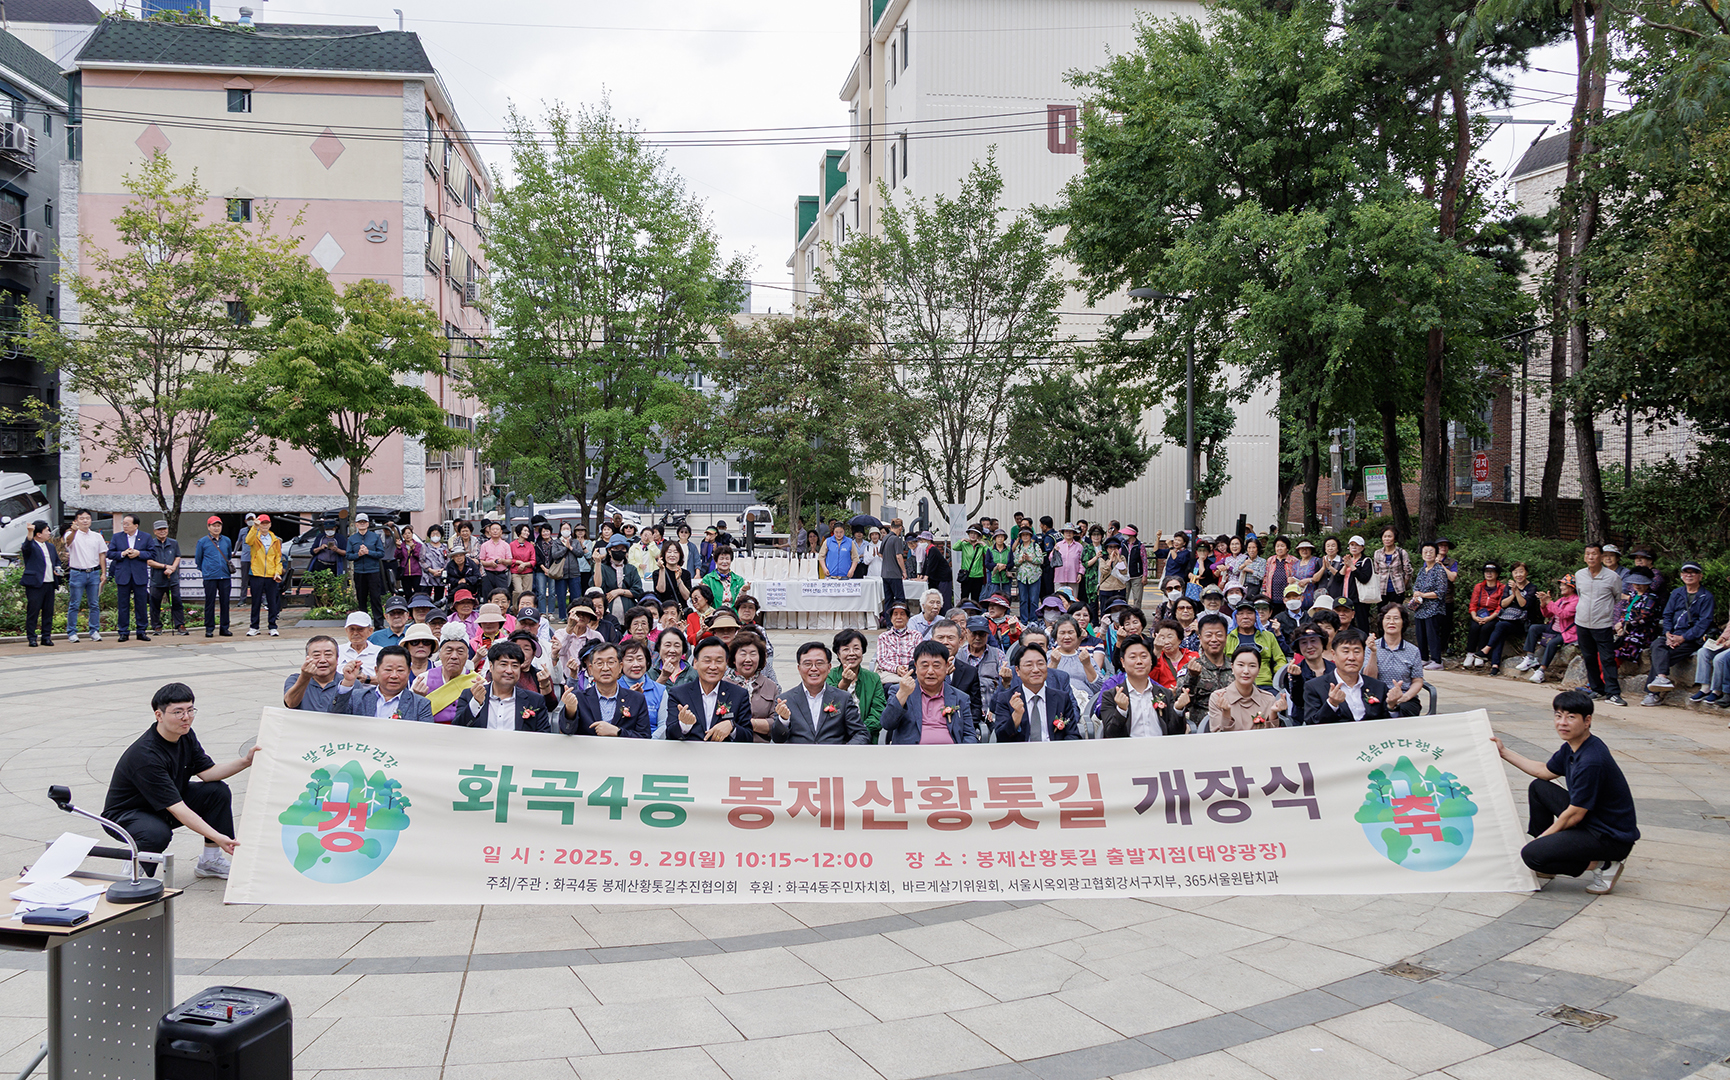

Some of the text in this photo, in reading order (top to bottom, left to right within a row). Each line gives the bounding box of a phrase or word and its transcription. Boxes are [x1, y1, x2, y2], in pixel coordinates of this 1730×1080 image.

[1475, 469, 1487, 478] STOP
[452, 762, 1322, 832] 화곡4동 봉제산황톳길 개장식
[317, 801, 369, 853] 경
[1391, 794, 1444, 842] 축
[553, 848, 619, 867] 2025.
[629, 850, 650, 868] 9.
[658, 850, 726, 869] 29(월)
[735, 851, 874, 869] 10:15~12:00
[976, 848, 1098, 869] 봉제산황톳길
[1106, 842, 1287, 866] 출발지점(태양광장)
[486, 876, 542, 892] 주최/주관
[552, 877, 598, 893] 화곡4동
[602, 878, 738, 894] 봉제산황톳길추진협의회
[749, 880, 773, 894] 후원
[785, 880, 895, 895] 화곡4동주민자치회,
[902, 879, 1004, 894] 바르게살기위원회,
[1007, 874, 1182, 892] 서울시옥외광고협회강서구지부,
[1184, 870, 1279, 887] 365서울원탑치과
